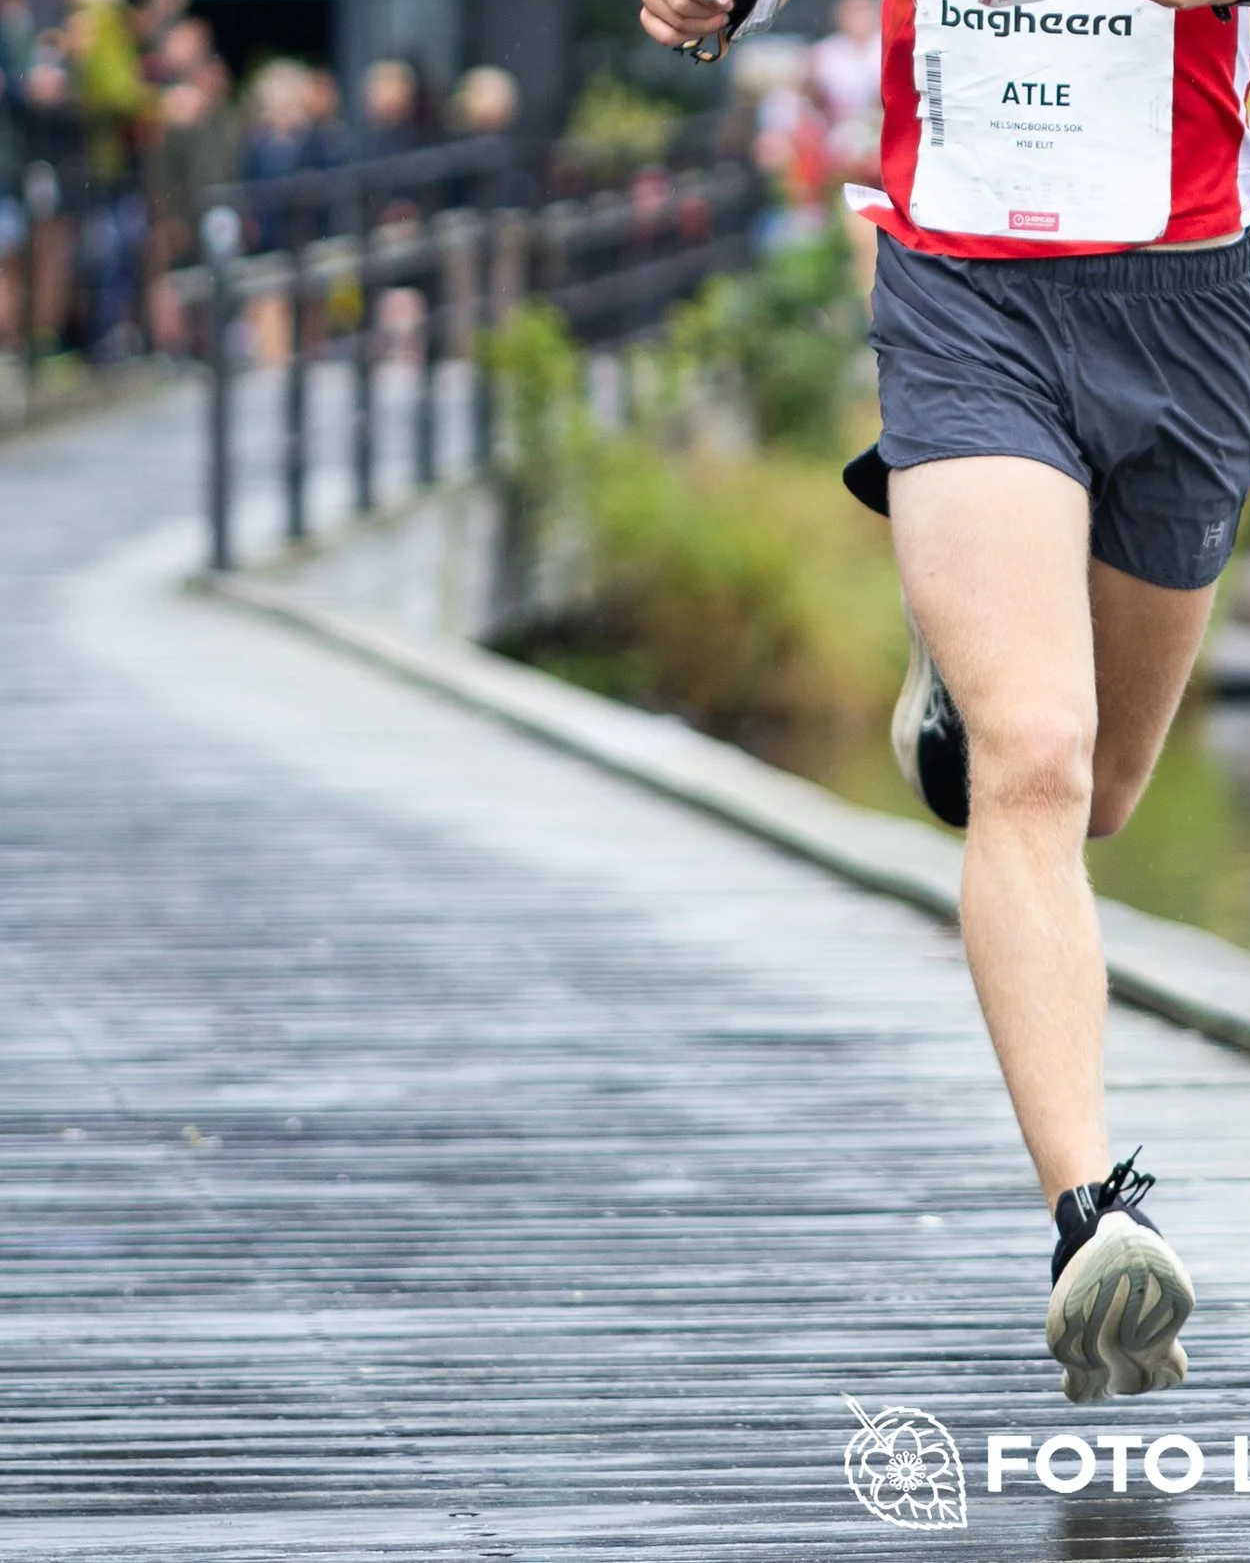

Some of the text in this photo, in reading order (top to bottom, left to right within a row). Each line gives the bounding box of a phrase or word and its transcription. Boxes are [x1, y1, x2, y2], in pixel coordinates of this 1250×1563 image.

[1001, 81, 1071, 107] ATLE
[990, 120, 1061, 132] HELSINGBORGS
[1035, 141, 1054, 149] ELIT
